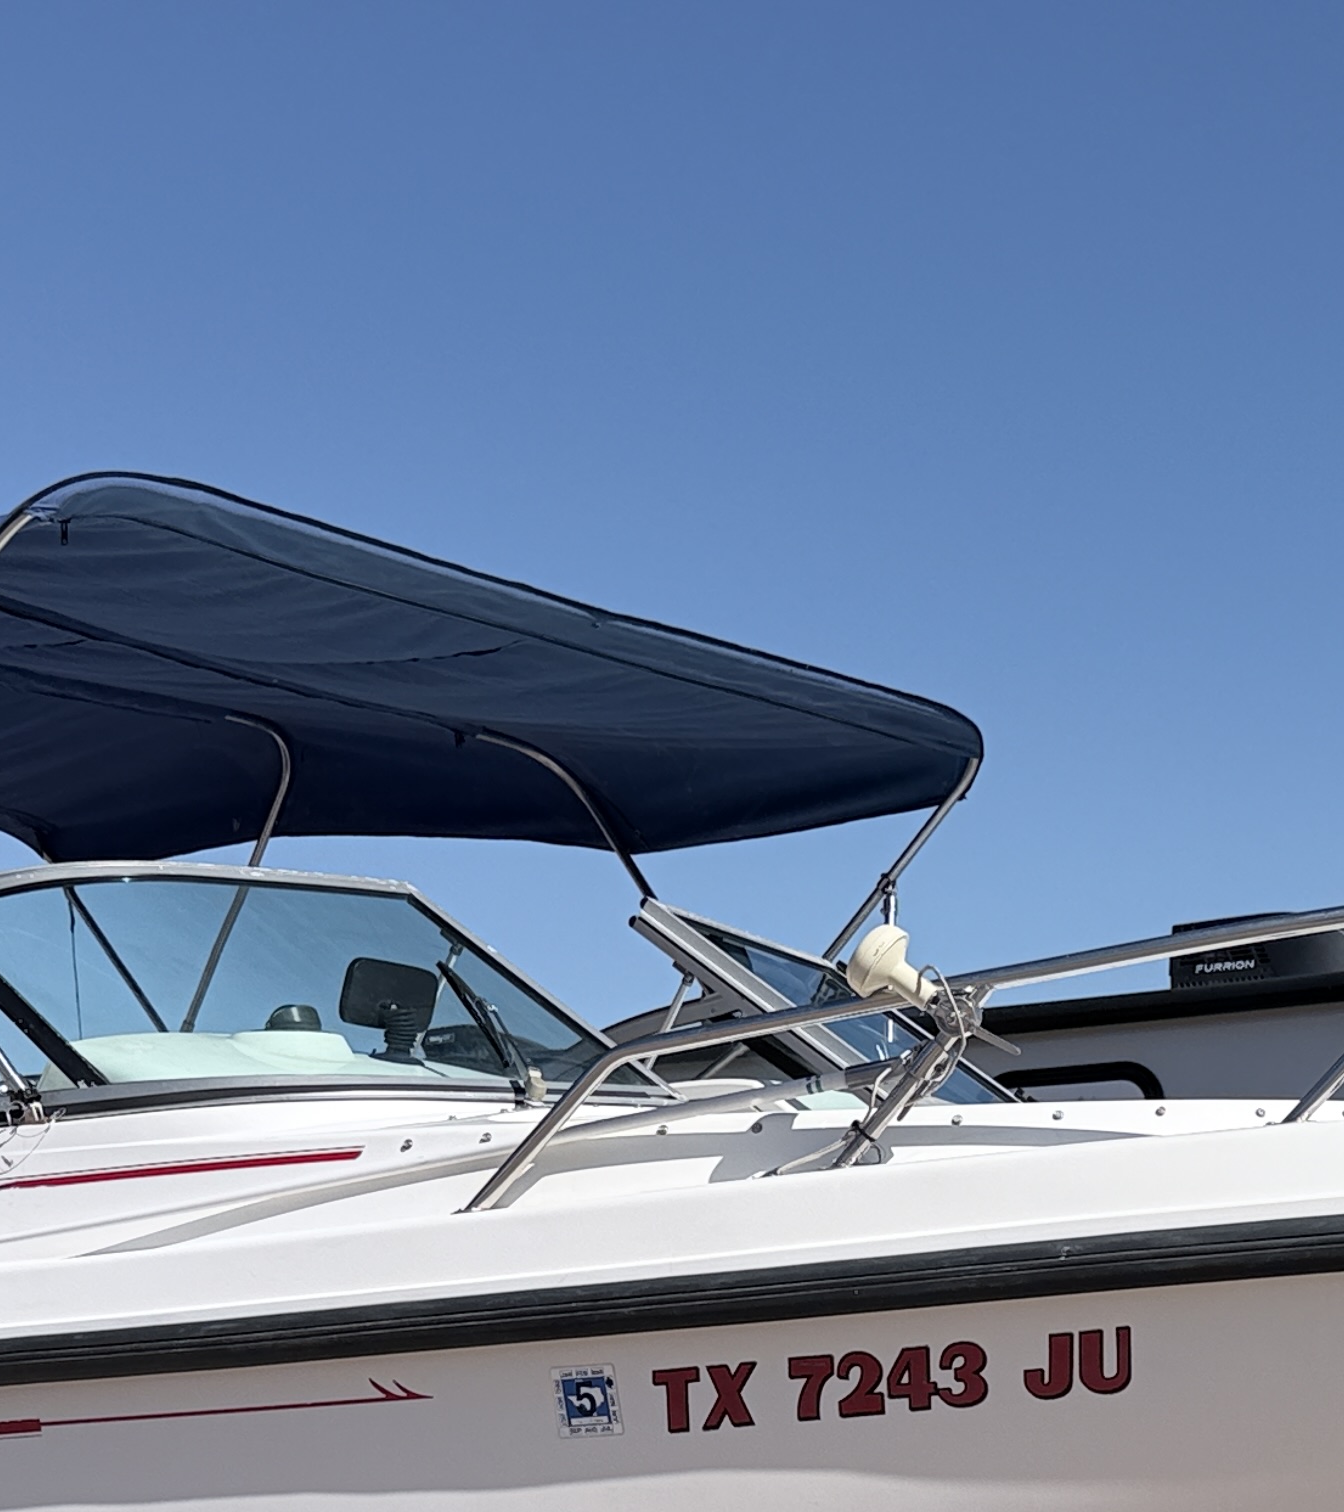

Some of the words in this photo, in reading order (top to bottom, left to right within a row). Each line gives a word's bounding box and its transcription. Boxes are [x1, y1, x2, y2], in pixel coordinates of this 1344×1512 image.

[1195, 959, 1255, 974] FURRION
[652, 1361, 757, 1433] TX
[788, 1341, 989, 1421] 7243
[1023, 1325, 1132, 1400] JU
